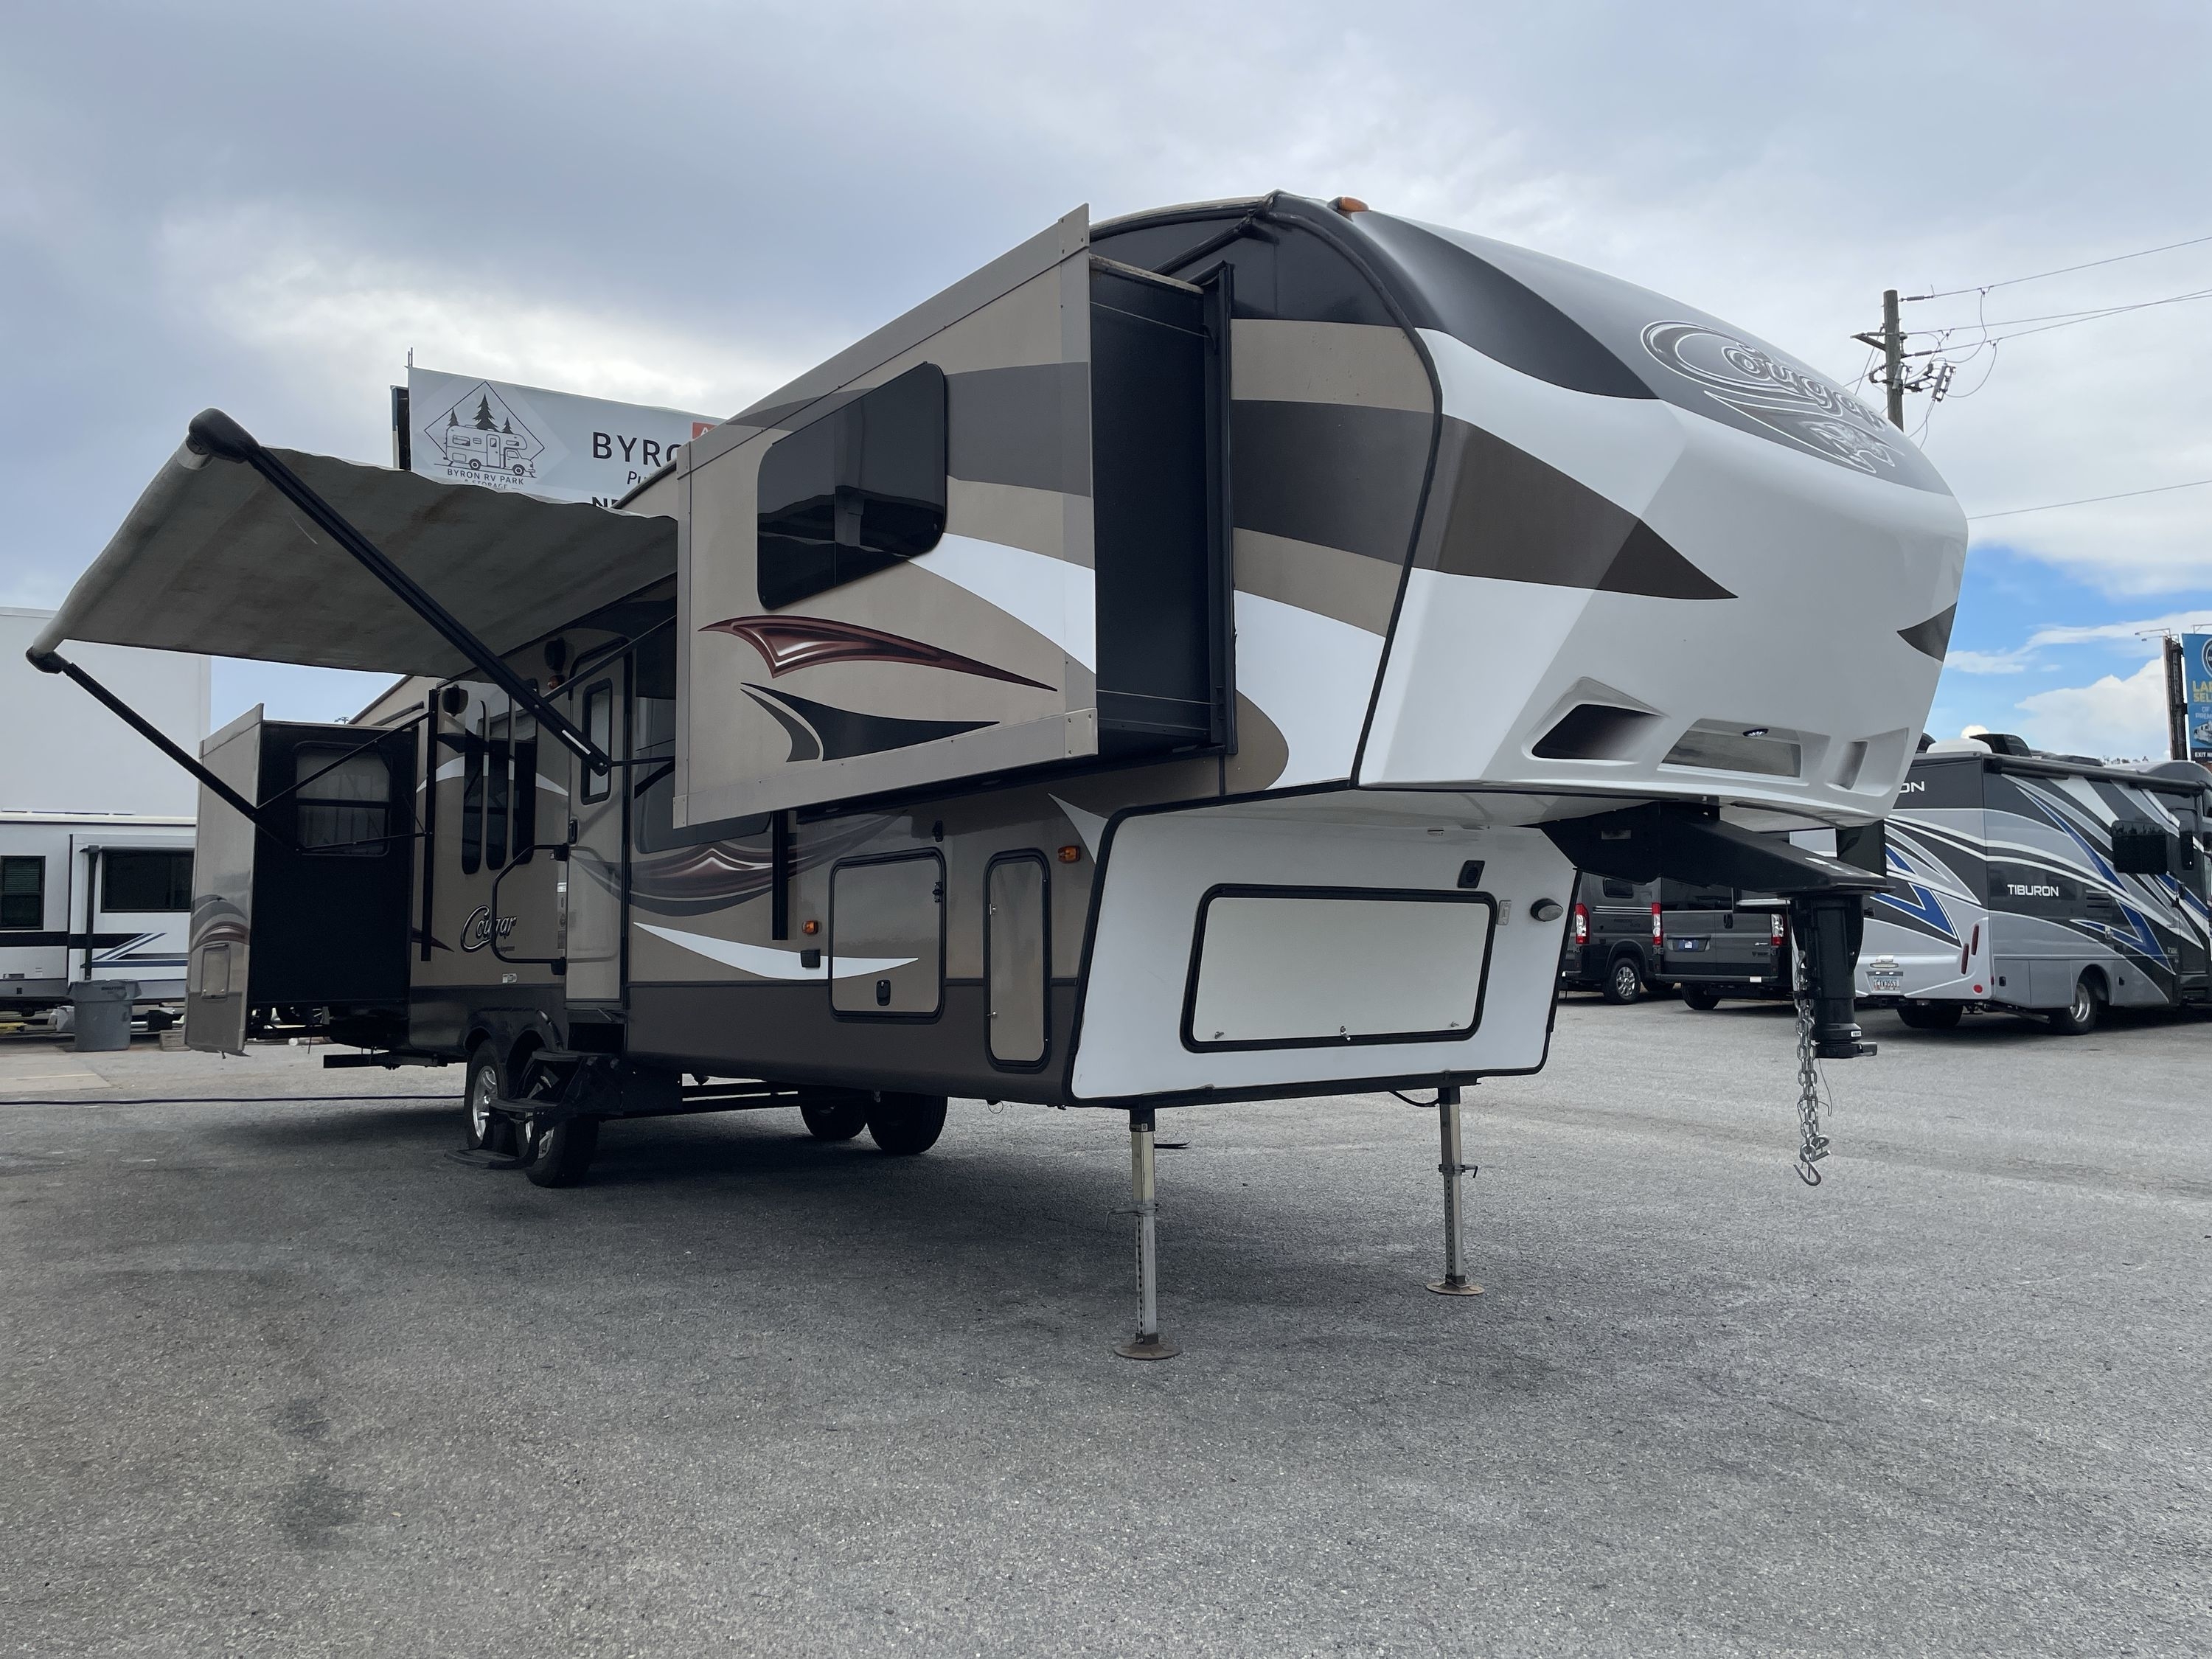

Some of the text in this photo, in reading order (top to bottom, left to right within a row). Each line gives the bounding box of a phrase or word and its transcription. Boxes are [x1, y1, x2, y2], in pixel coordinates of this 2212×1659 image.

[447, 468, 524, 485] BYRON RV PARK
[2007, 884, 2059, 897] TIBURON
